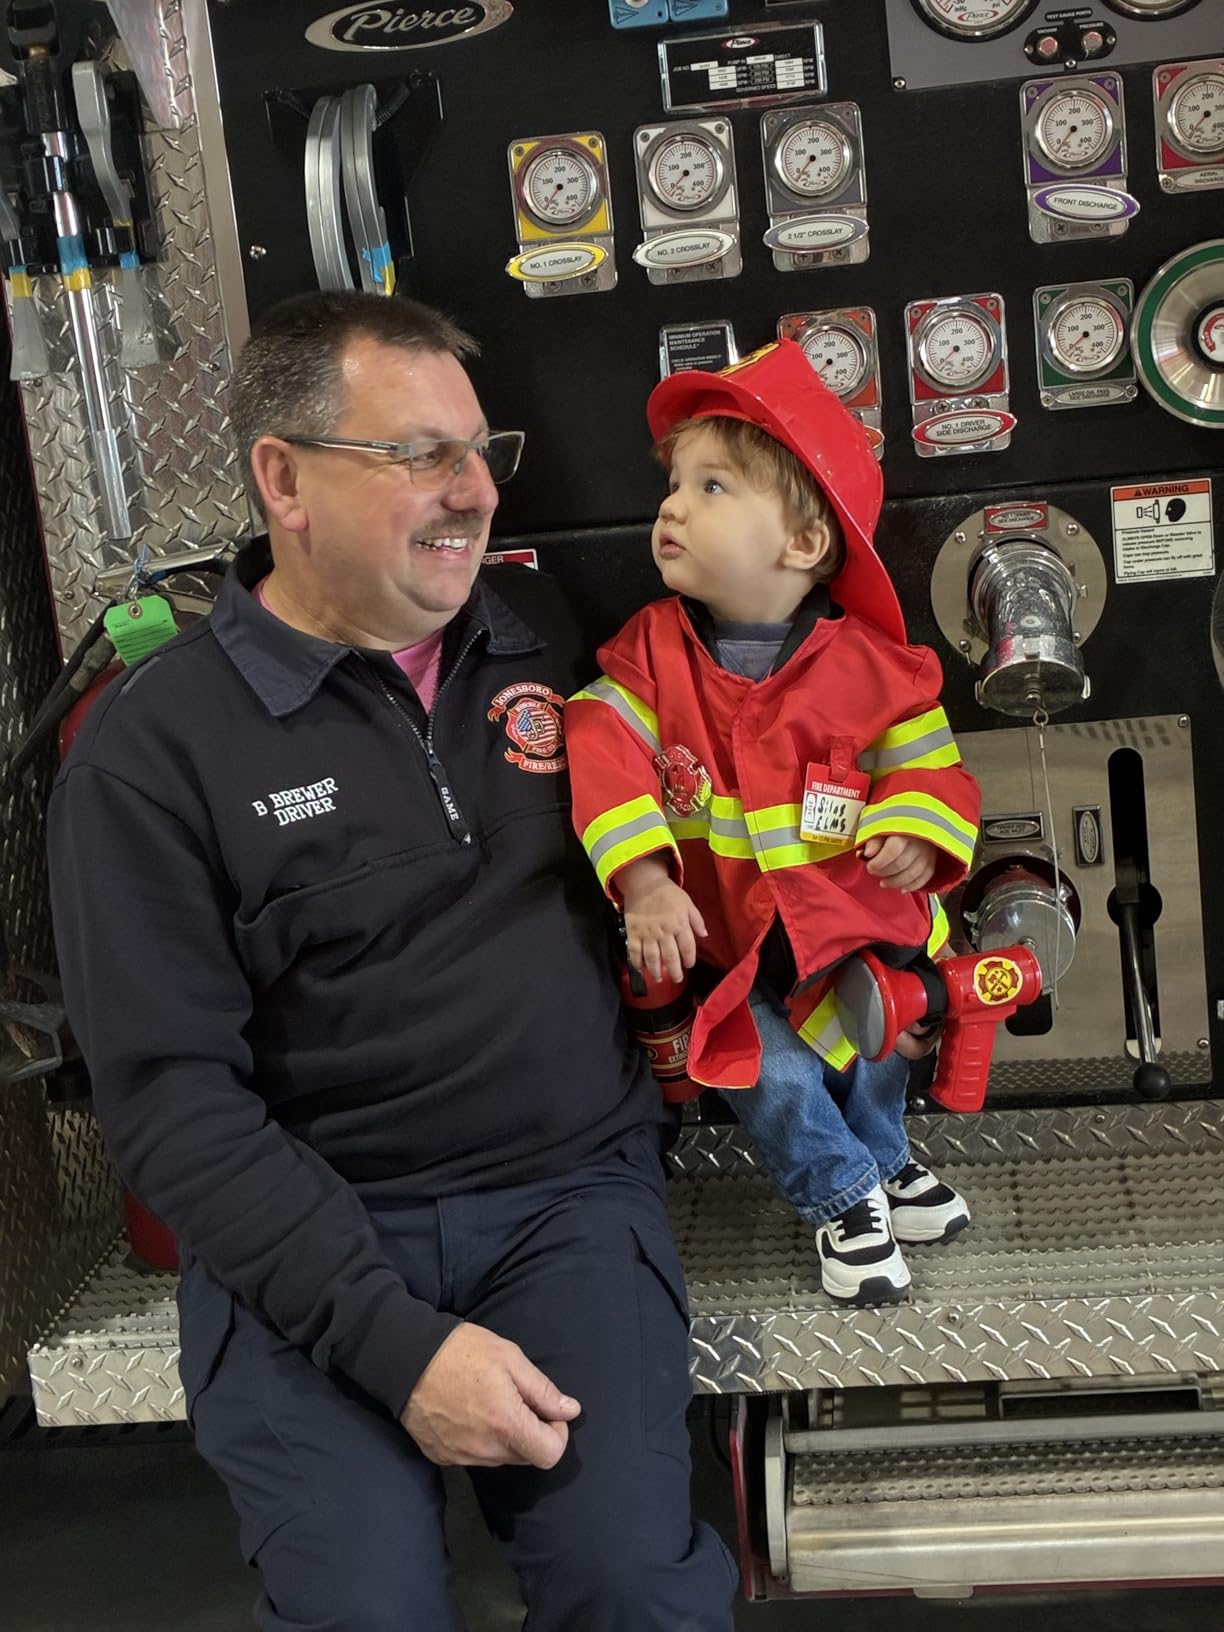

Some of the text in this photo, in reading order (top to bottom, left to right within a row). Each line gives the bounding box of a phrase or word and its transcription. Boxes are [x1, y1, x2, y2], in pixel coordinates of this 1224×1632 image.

[342, 7, 477, 41] Pierce
[1068, 107, 1081, 115] 200
[1081, 118, 1094, 126] 300
[680, 151, 693, 159] 200
[553, 166, 566, 174] 200
[1053, 197, 1119, 211] FRONT DISCHARGE
[808, 227, 843, 238] CROSSLAY
[675, 241, 711, 254] CROSSLAY
[530, 262, 541, 270] NO.
[548, 255, 583, 267] CROSSLAY
[691, 329, 721, 337] OPERATION
[669, 337, 706, 345] MAINTENANCE
[811, 352, 823, 360] 100
[836, 351, 848, 359] 300
[952, 424, 992, 435] DISCHARGE
[959, 419, 985, 428] DRIVER
[1143, 484, 1189, 496] WARNING
[495, 684, 550, 706] JONESBORO
[811, 781, 861, 799] FIRE DEPARTMENT
[251, 777, 339, 817] B BREWER
[441, 787, 460, 821] GAME
[817, 796, 847, 817] Silas
[273, 797, 337, 826] DRIVER
[672, 1034, 689, 1055] FIR
